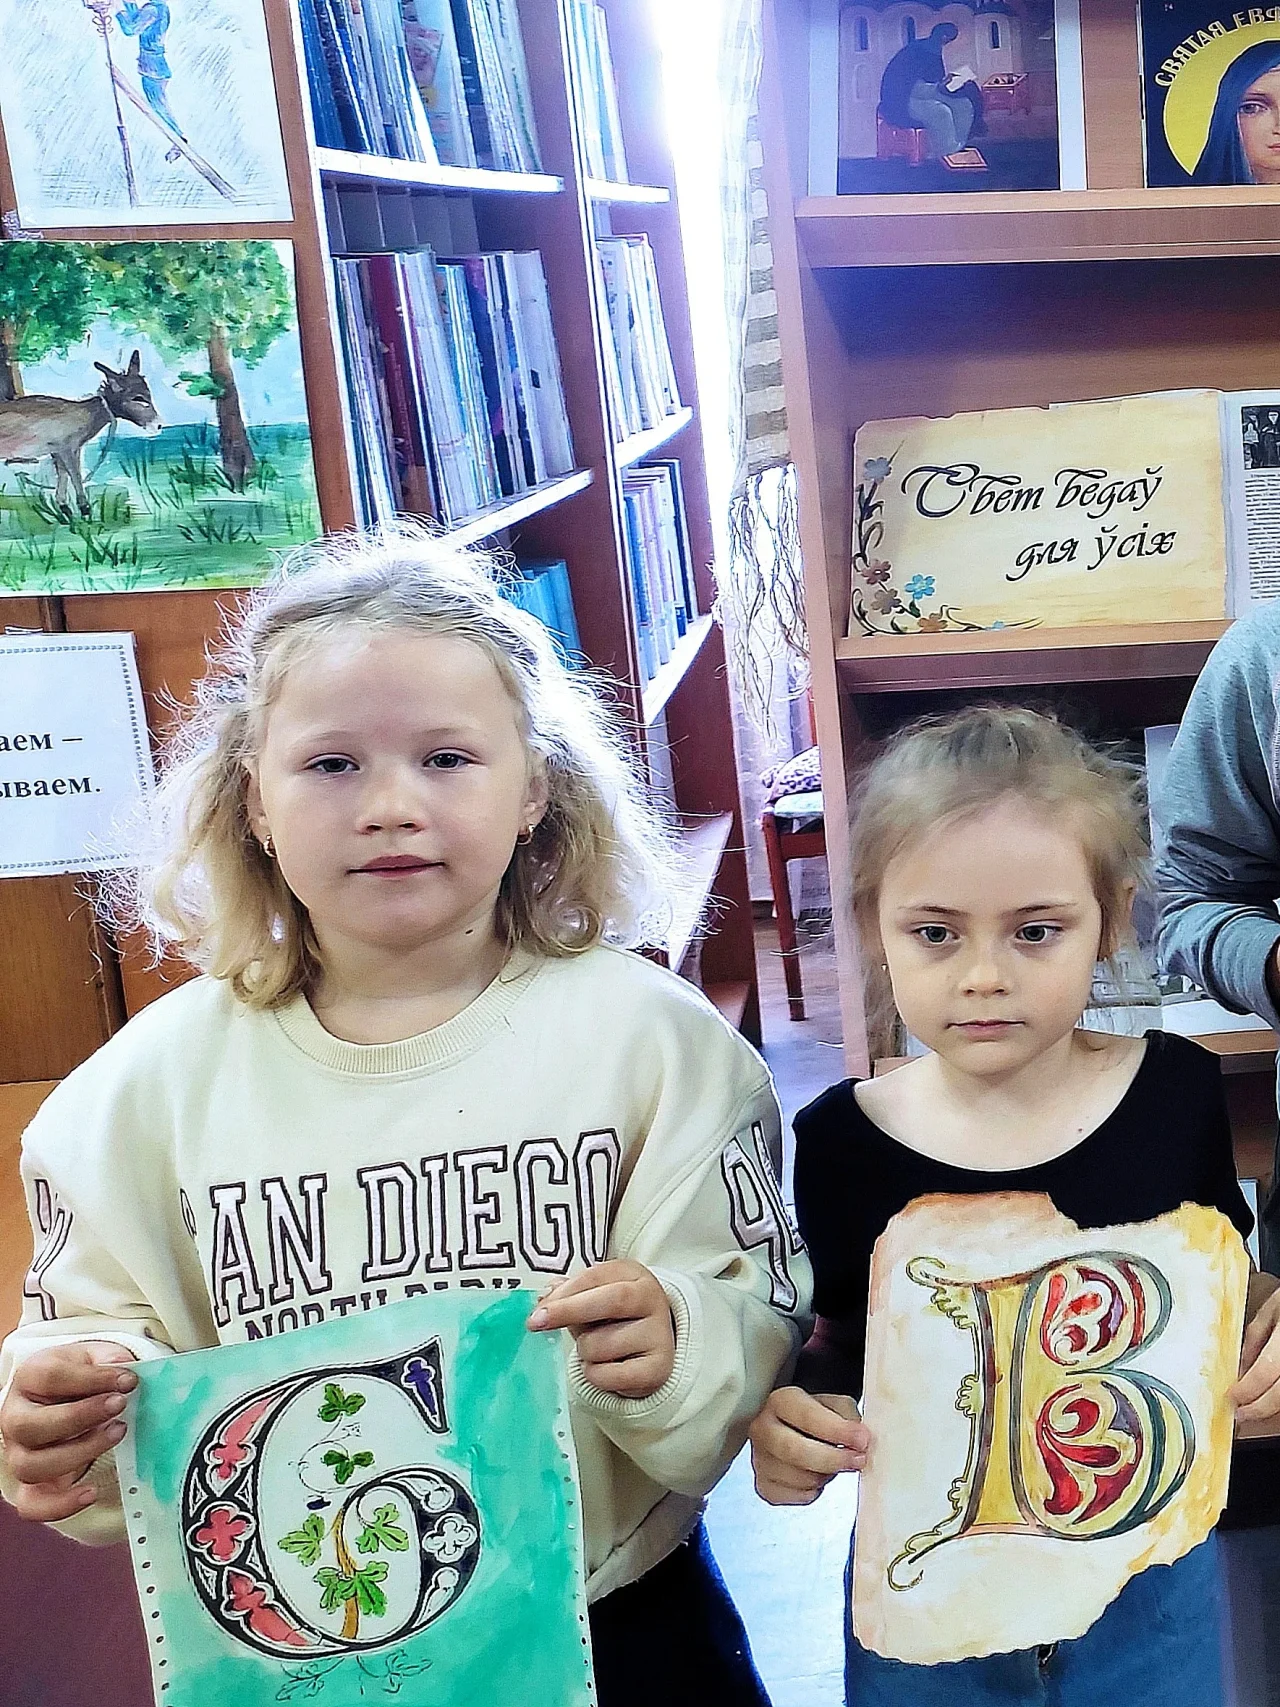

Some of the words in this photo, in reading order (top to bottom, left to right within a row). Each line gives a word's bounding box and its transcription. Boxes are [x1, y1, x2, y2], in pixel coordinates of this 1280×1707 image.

[1154, 20, 1227, 87] СВЯТАЯ
[901, 463, 1045, 518] Свет
[180, 1173, 333, 1327] AN
[356, 1127, 622, 1284] DIEGO
